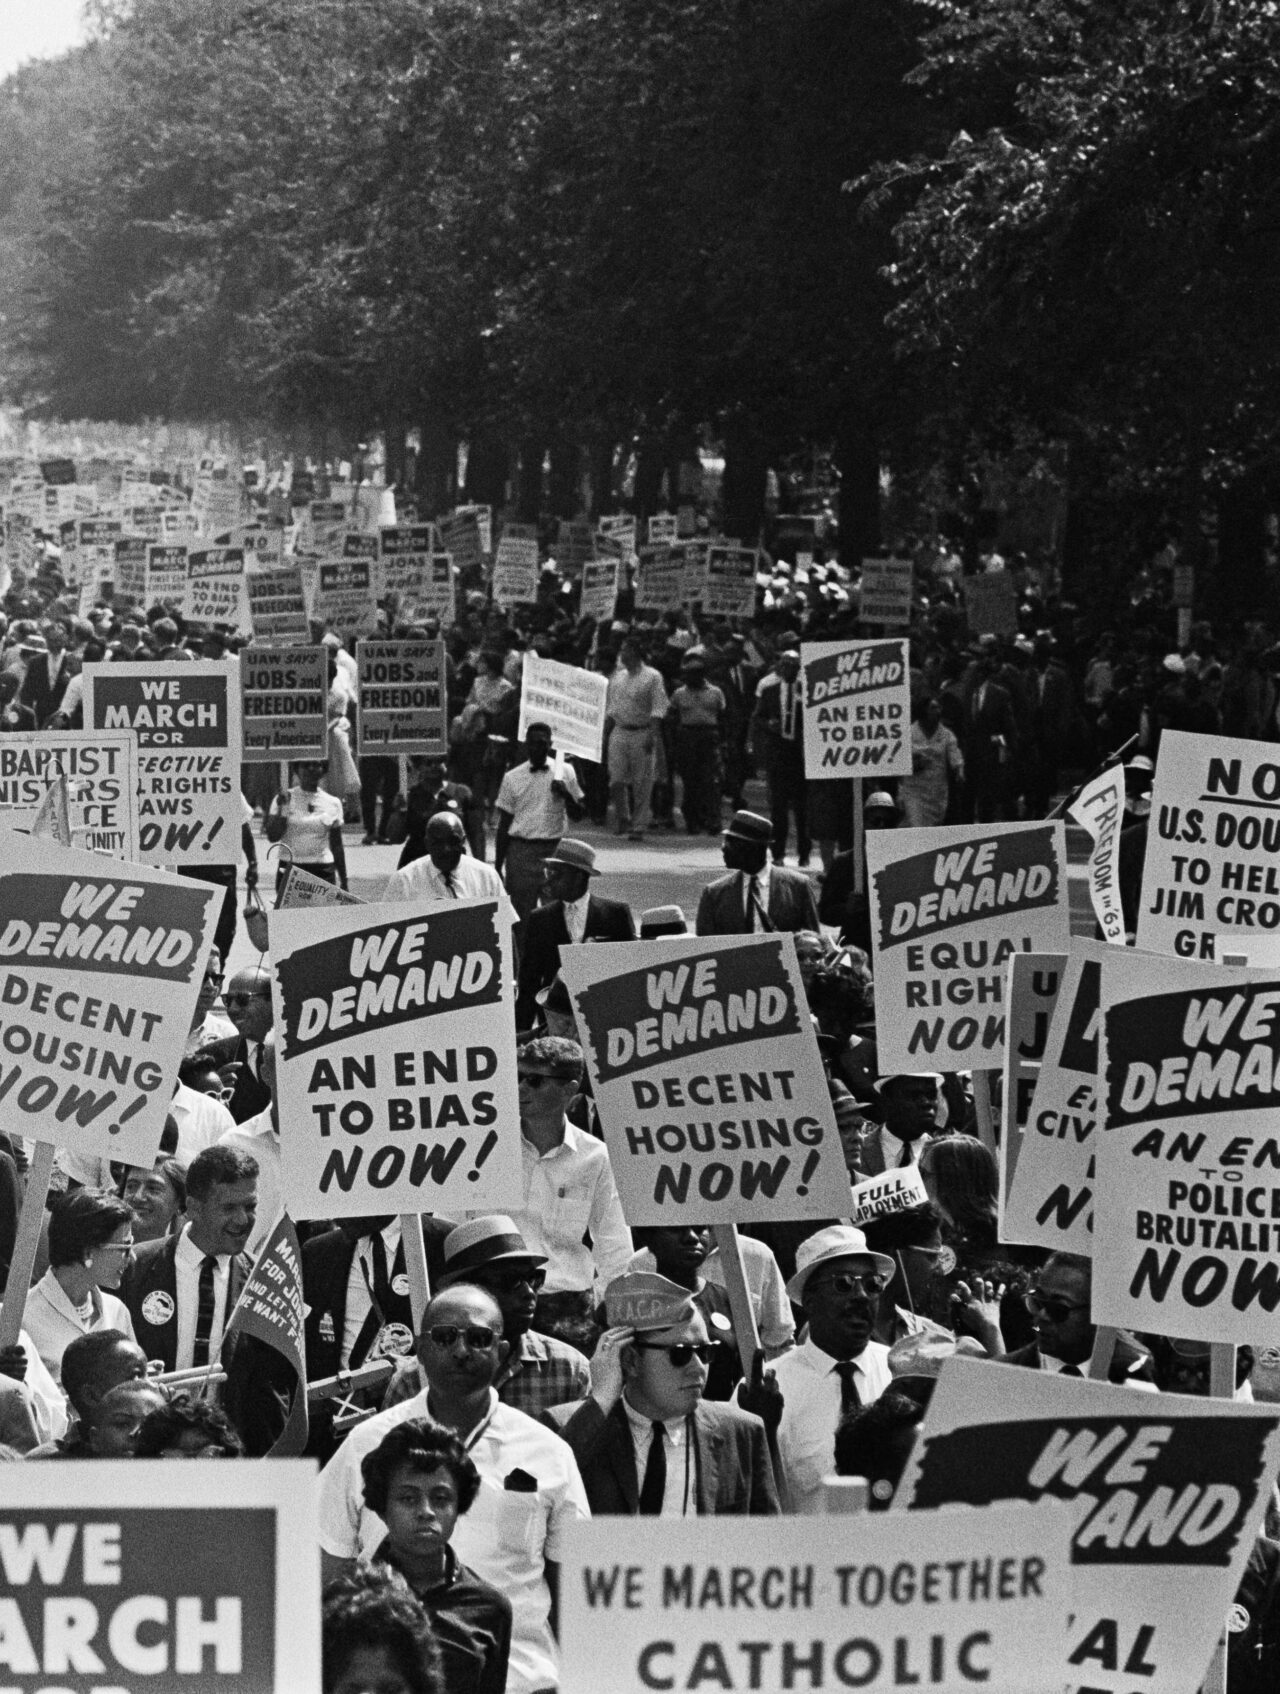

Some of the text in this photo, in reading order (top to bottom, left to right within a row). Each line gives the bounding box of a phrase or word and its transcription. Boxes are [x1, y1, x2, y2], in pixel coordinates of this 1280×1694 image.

[248, 654, 281, 665] UAW
[365, 646, 397, 658] UAW
[837, 649, 873, 674] WE
[140, 680, 181, 701] WE
[245, 669, 297, 690] JOBS
[362, 662, 415, 682] JOBS
[813, 662, 902, 701] DEMAND
[104, 703, 217, 729] MARCH
[245, 696, 320, 716] FREEDOM
[361, 688, 440, 708] FREEDOM
[817, 703, 902, 723] AN END
[140, 731, 184, 744] FOR
[820, 724, 902, 742] TO BIAS
[1, 747, 121, 777] BAPTIST
[138, 756, 223, 773] FECTIVE
[822, 741, 902, 767] NOW!
[163, 777, 232, 794] RIGHTS
[1207, 757, 1280, 802] NO
[138, 799, 193, 815] AWS
[1158, 805, 1207, 844] U.S.
[138, 816, 224, 851] OW!
[1083, 784, 1118, 893] FREEDOM
[933, 841, 999, 886] WE
[1171, 855, 1280, 895] TO HEL
[60, 881, 144, 921] WE
[890, 864, 1051, 936] DEMAND
[1150, 887, 1280, 929] JIM CRO
[350, 922, 429, 978] WE
[296, 951, 493, 1041] DEMAND
[646, 958, 718, 1010] WE
[906, 974, 1008, 1008] RIGH
[1, 974, 163, 1043] DECENT
[607, 986, 788, 1067] DEMAND
[1182, 990, 1280, 1048] WE
[307, 1046, 498, 1093] AN END
[1120, 1043, 1280, 1113] DEMA
[631, 1070, 795, 1109] DECENT
[312, 1091, 498, 1137] TO BIAS
[625, 1116, 824, 1155] HOUSING
[1131, 1127, 1280, 1170] AN EN
[319, 1129, 498, 1193] NOW!
[654, 1149, 821, 1205] NOW!
[1198, 1167, 1244, 1183] TO
[858, 1179, 906, 1206] FULL
[260, 1258, 286, 1285] FOR
[253, 1300, 287, 1328] WANT
[266, 1291, 288, 1310] LET
[1028, 1425, 1173, 1488] WE
[583, 1555, 1047, 1610] WE MARCH TOGETHER
[637, 1630, 993, 1691] CATHOLIC
